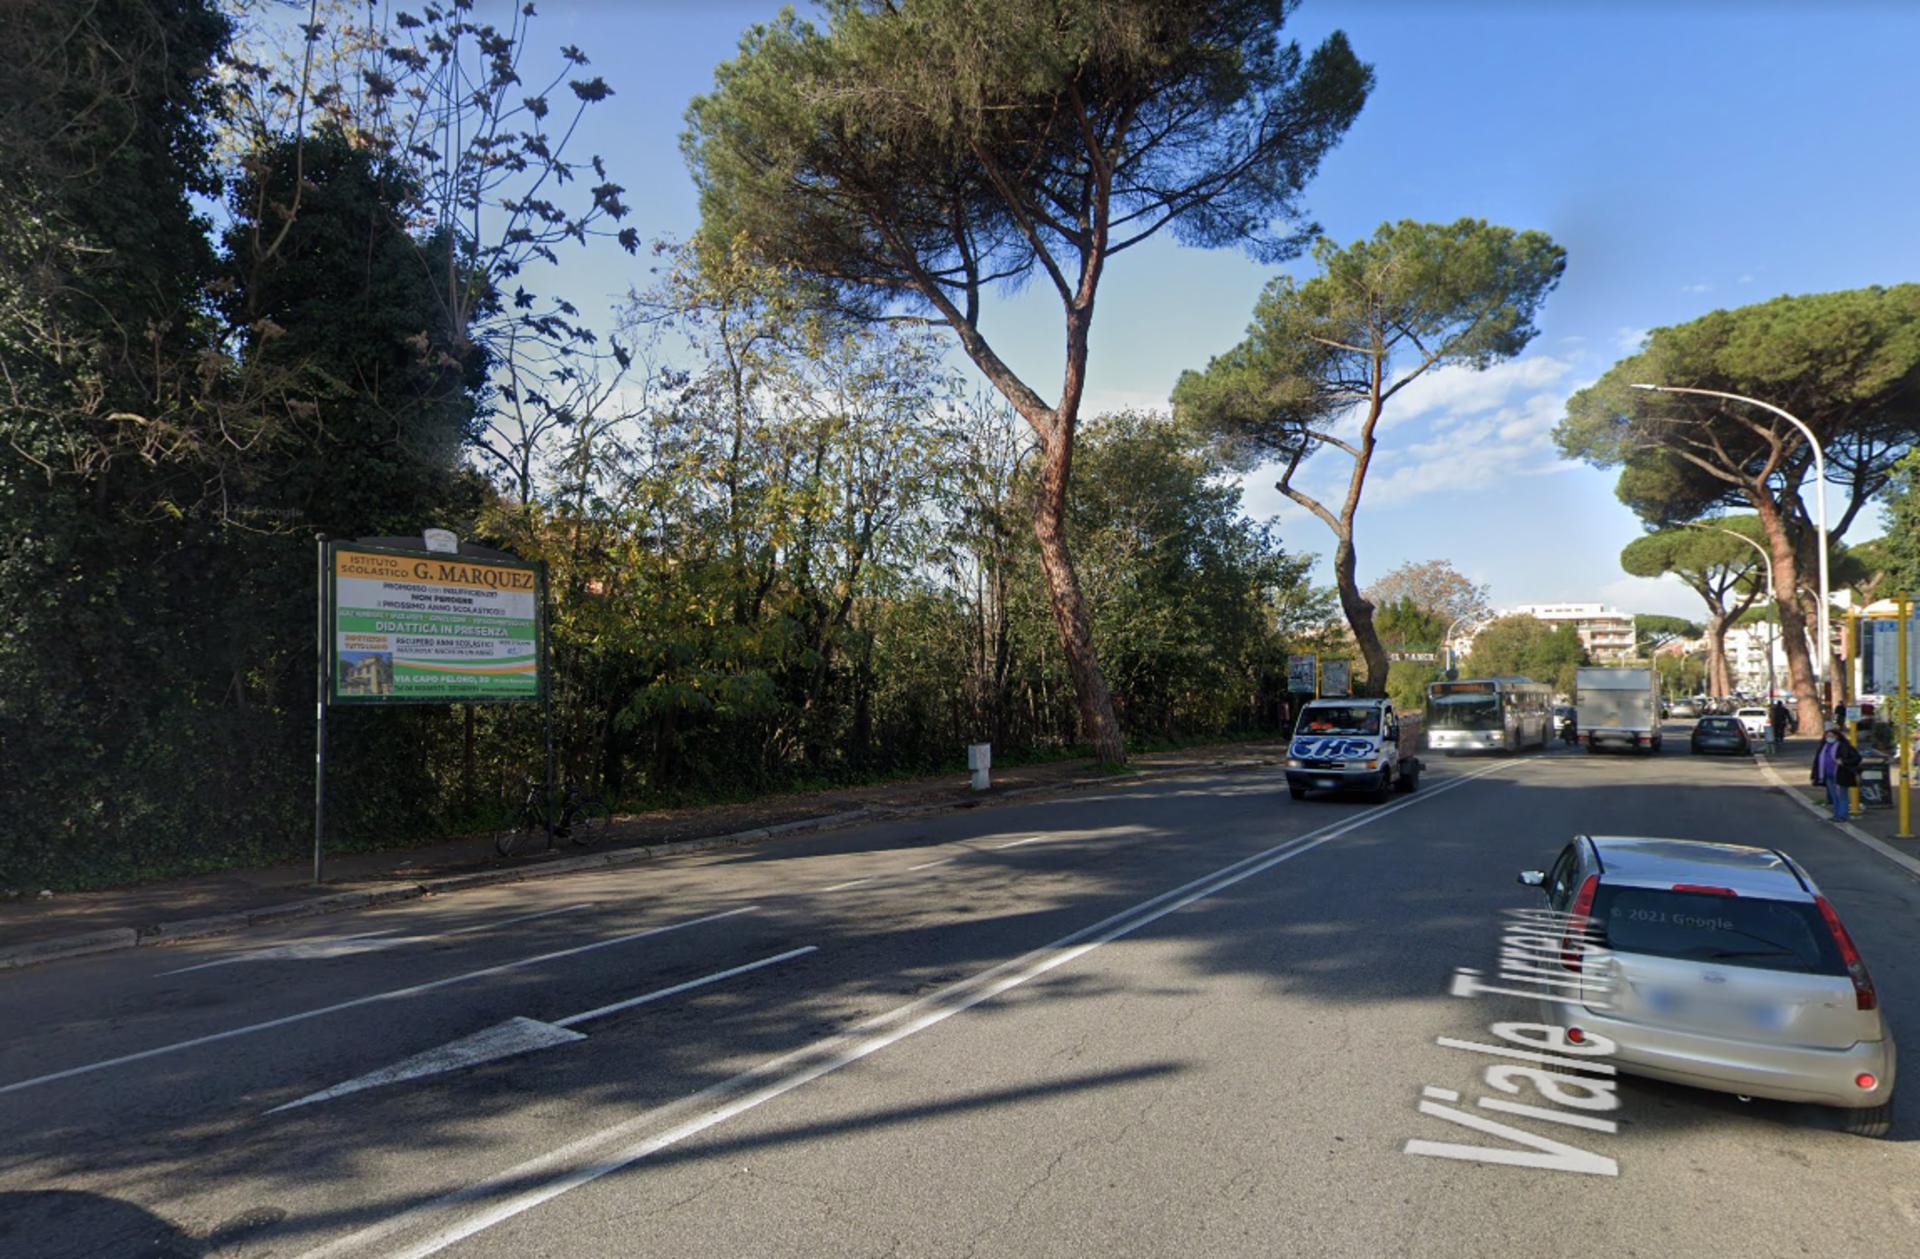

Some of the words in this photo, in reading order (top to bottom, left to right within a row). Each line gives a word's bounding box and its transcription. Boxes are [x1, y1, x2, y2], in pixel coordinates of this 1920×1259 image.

[350, 556, 398, 568] ISTITUTO
[340, 564, 409, 578] SCOLASTICO
[413, 562, 434, 580] G.
[438, 564, 533, 590] MARQUEZ
[383, 582, 427, 593] PROMOSSO
[411, 593, 433, 602] NON
[383, 600, 425, 611] PROSSIMO
[427, 603, 451, 612] ANNO
[375, 621, 438, 633] DIDATTICA
[440, 624, 452, 635] IN
[454, 626, 509, 638] PRESENZA
